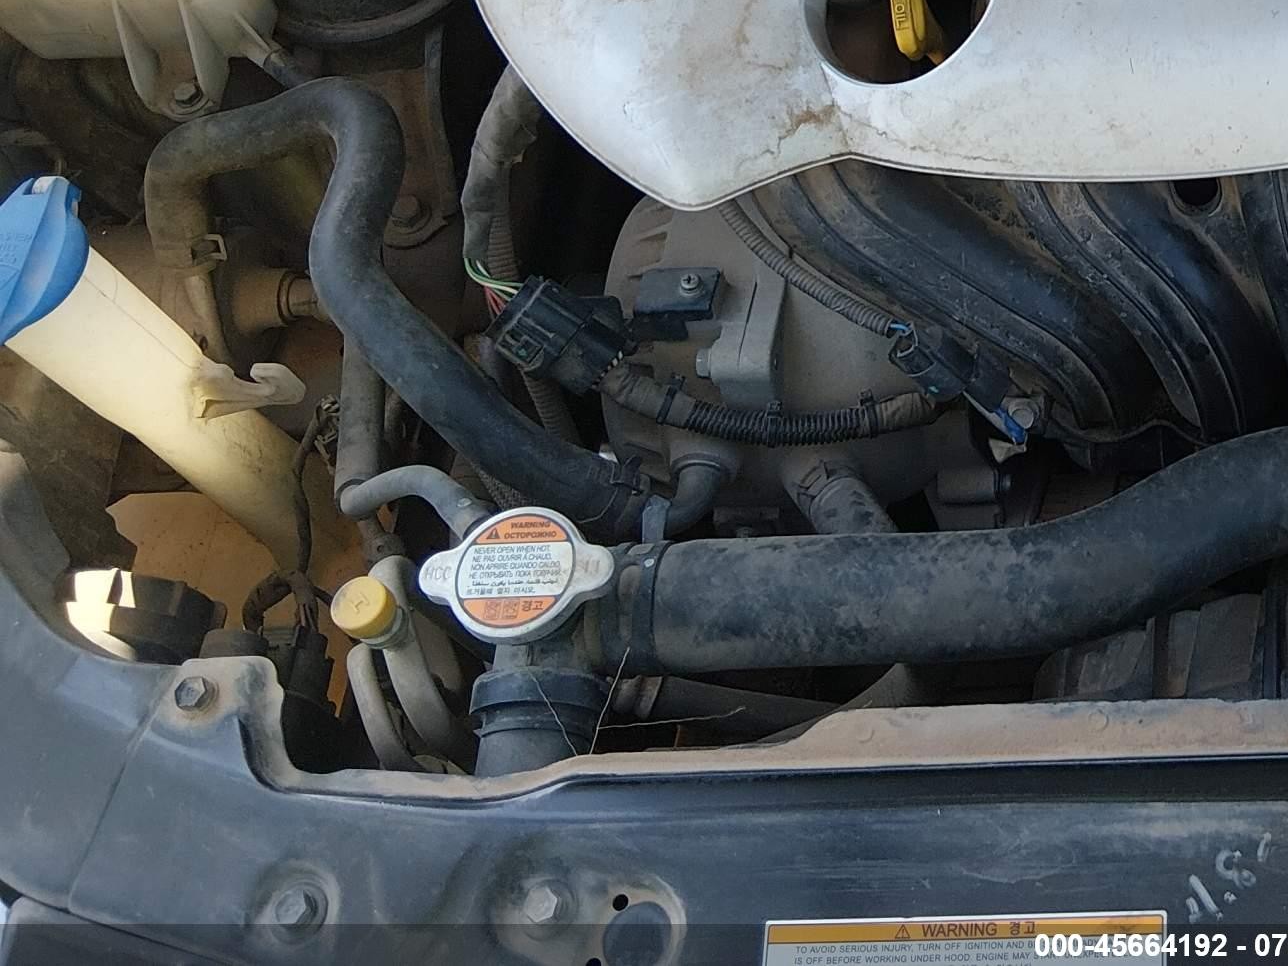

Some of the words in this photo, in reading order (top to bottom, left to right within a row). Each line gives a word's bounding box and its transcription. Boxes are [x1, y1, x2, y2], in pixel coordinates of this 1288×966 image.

[894, 3, 907, 29] OIL
[511, 521, 551, 530] WARNING
[504, 530, 558, 540] ОСТОРОЖНО
[474, 546, 496, 555] NEVER
[497, 546, 515, 554] OPEN
[516, 545, 536, 554] WHEN
[471, 563, 485, 571] NON
[510, 562, 537, 570] QUANDO
[522, 600, 544, 612] 경고
[921, 922, 997, 938] WARNING
[1011, 921, 1036, 935] 경고
[796, 945, 808, 954] TO
[811, 944, 837, 954] AVOID
[840, 943, 879, 953] SERIOUS
[917, 941, 944, 951] TURN
[946, 941, 962, 950] OFF
[965, 940, 1008, 950] IGNITION
[1010, 940, 1030, 949] AND
[794, 957, 804, 966] IS
[806, 956, 821, 966] OFF
[826, 955, 862, 966] BEFORE
[865, 954, 909, 965] WORKING
[910, 953, 941, 963] UNDER
[976, 951, 1009, 962] ENGINE
[1012, 950, 1031, 961] MAY
